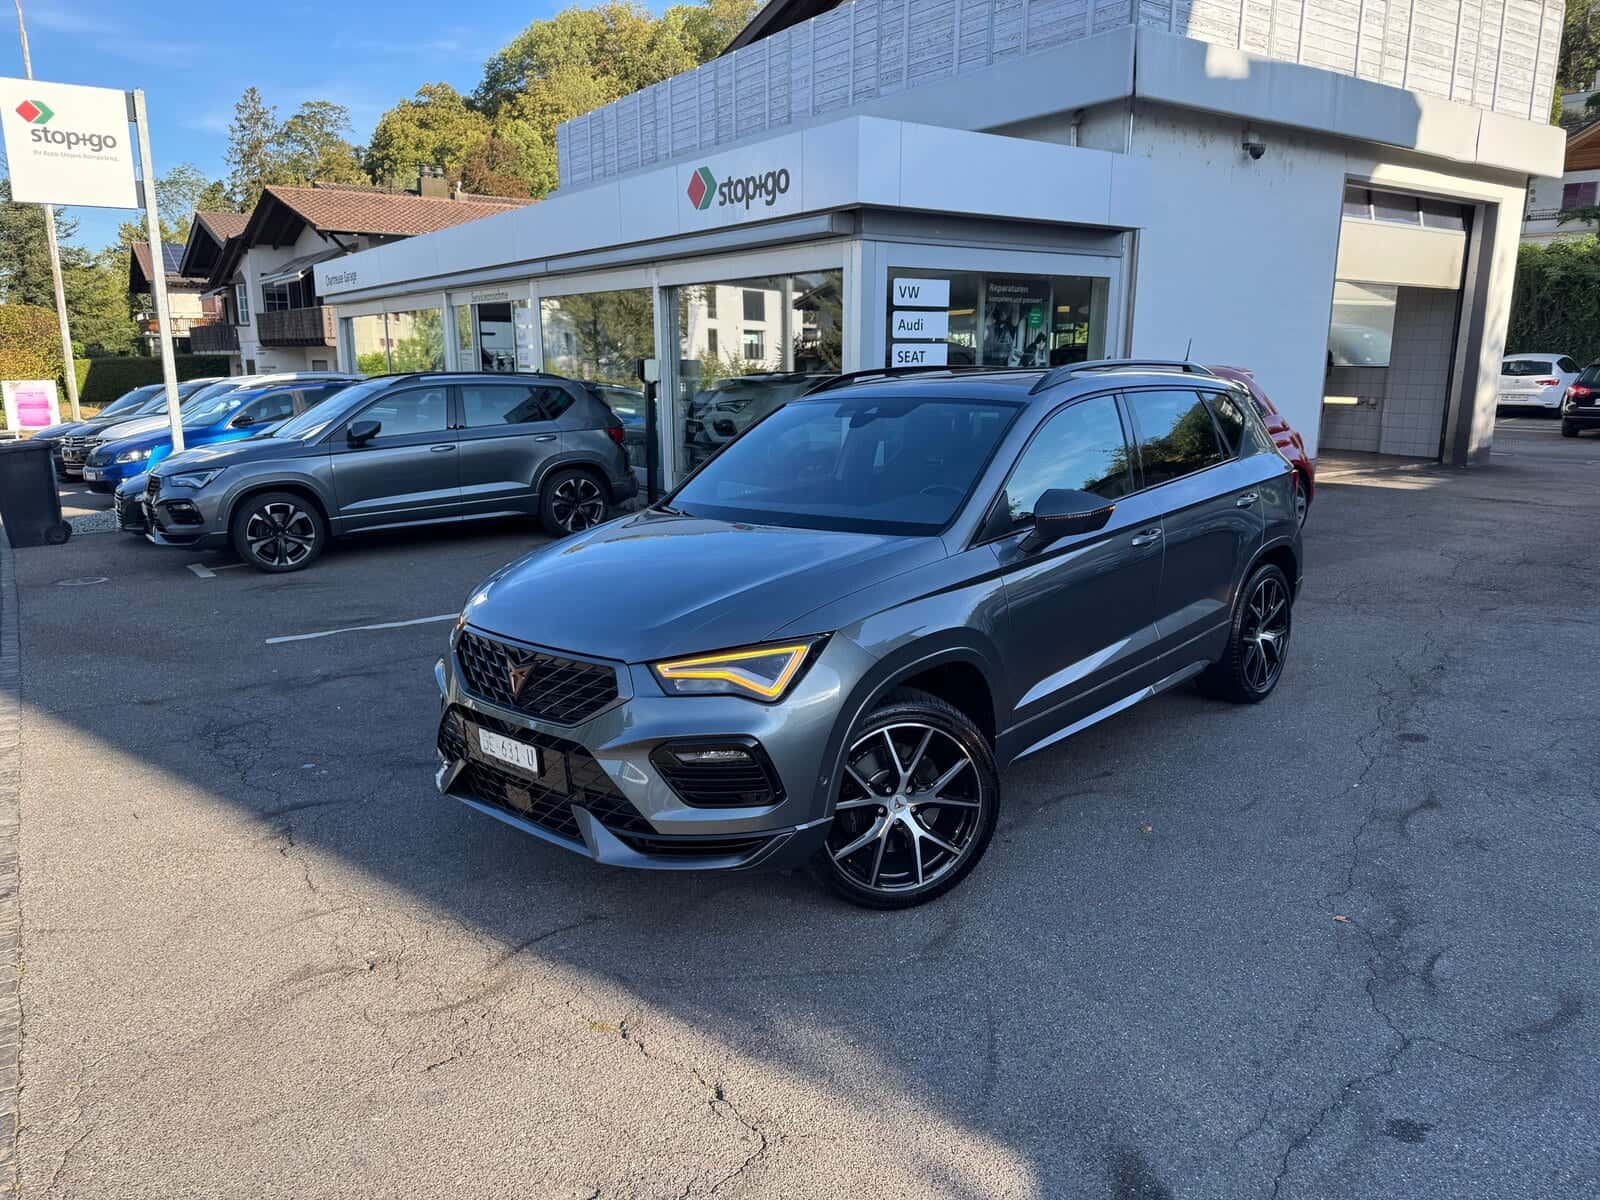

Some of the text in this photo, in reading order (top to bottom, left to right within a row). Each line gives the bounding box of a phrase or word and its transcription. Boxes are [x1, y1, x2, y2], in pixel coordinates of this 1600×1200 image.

[31, 127, 117, 152] stop+go
[718, 168, 790, 210] stop+go
[899, 286, 920, 299] VW
[898, 319, 924, 331] Audi
[897, 350, 926, 364] SEAT
